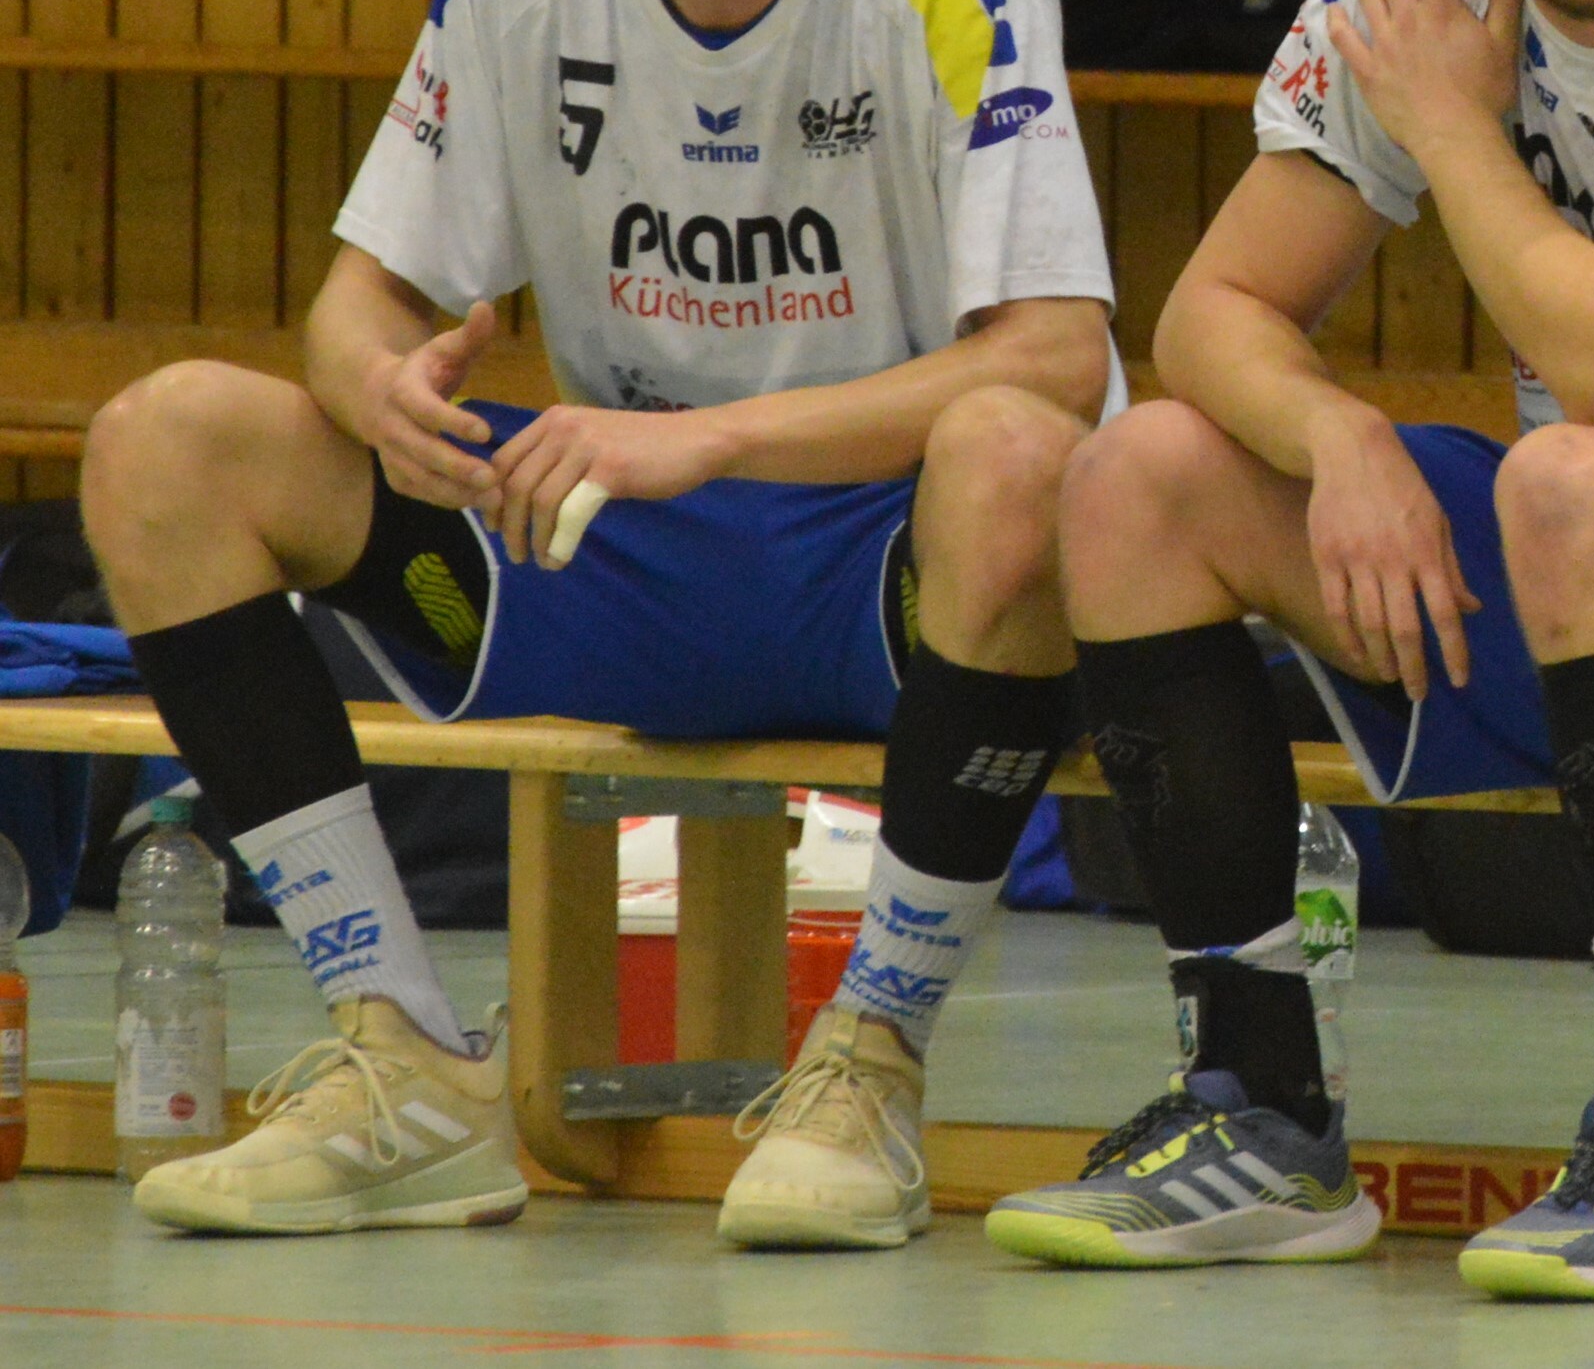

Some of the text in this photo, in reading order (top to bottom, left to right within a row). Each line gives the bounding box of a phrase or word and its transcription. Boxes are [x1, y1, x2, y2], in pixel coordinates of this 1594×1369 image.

[558, 55, 616, 176] 5
[681, 140, 760, 163] erima
[608, 272, 856, 329] Küchenland
